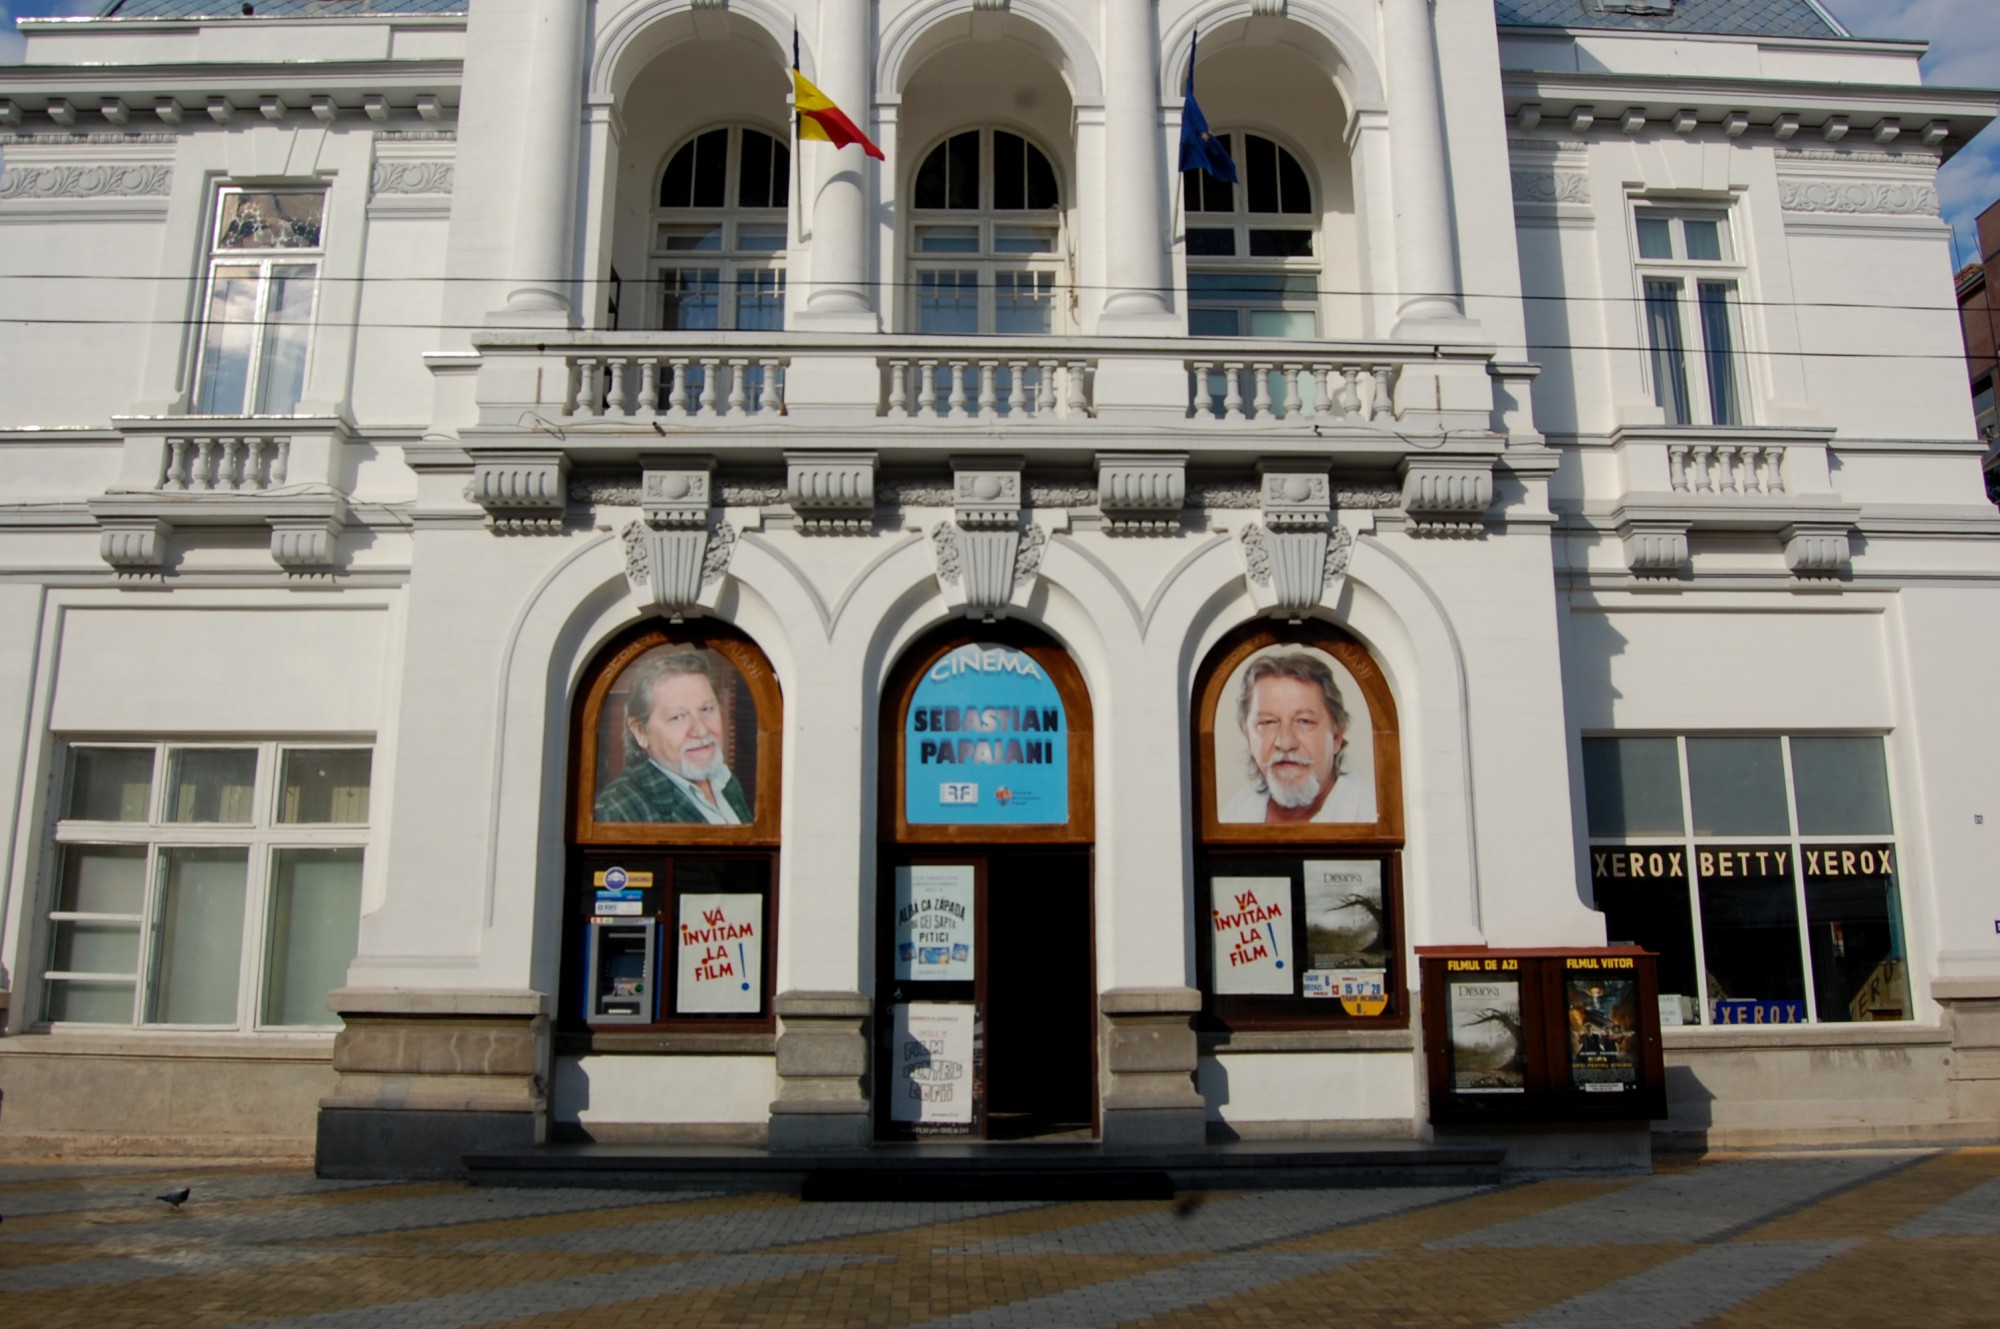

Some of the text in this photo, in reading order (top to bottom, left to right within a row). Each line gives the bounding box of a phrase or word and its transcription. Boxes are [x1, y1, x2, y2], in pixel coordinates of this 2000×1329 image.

[930, 652, 1042, 681] CINEMA
[914, 707, 1059, 733] SEBASTIAN
[920, 740, 1053, 765] PAPAIANI
[1595, 850, 1894, 878] XEROX BETTY XEROX
[1323, 873, 1363, 884] DEMONI
[921, 899, 932, 912] CA
[919, 932, 950, 943] PITICI
[1240, 928, 1263, 945] LA
[706, 945, 729, 961] LA
[1447, 959, 1518, 971] FILMUL DE AZI
[1566, 958, 1634, 969] FILMUL VIITOR
[1345, 983, 1353, 995] 15
[1458, 986, 1500, 997] DEMONI
[1721, 1004, 1797, 1025] XEROX
